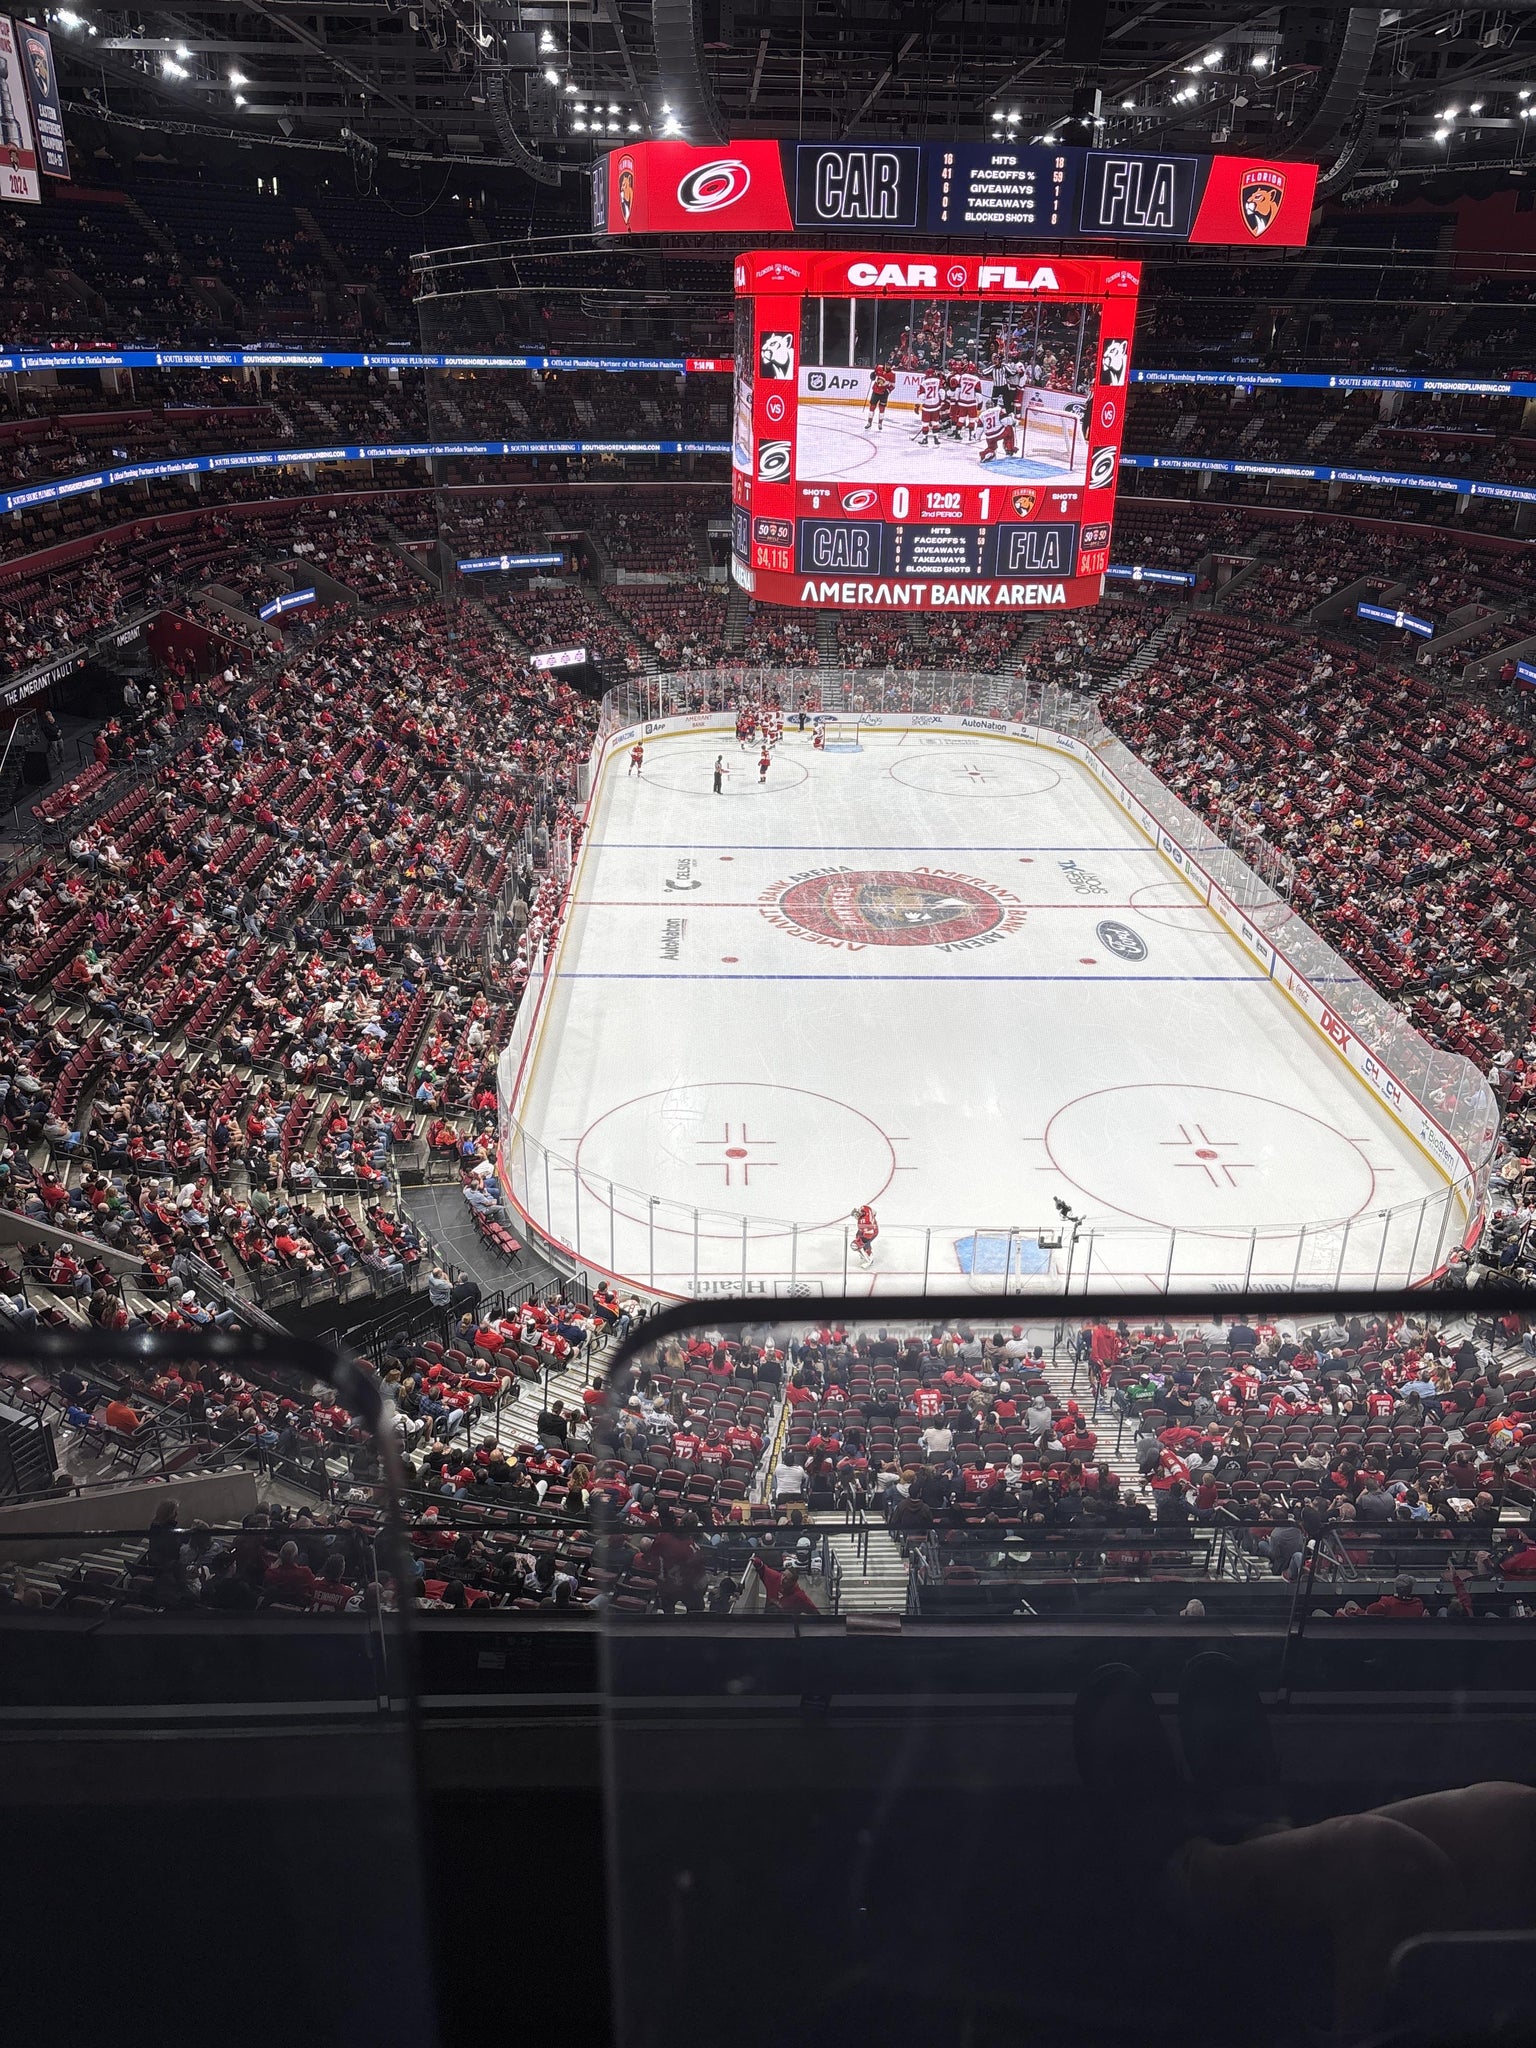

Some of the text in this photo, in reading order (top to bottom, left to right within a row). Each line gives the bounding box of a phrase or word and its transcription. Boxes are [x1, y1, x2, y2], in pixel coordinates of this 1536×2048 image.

[991, 156, 1017, 166] HITS
[941, 168, 1063, 183] 41 FACEOFFS % 59
[1245, 173, 1282, 186] FLORIDA
[9, 175, 28, 195] 2024
[816, 152, 899, 218] CAR
[970, 184, 1033, 194] GIVEAWAYS
[1055, 186, 1059, 197] 1
[1100, 161, 1174, 227] FLA
[942, 196, 1058, 211] 0 TAKEAWAYS 1
[941, 211, 947, 222] 4
[965, 212, 1005, 222] BLOCKED
[1005, 213, 1035, 223] SHOTS
[847, 262, 1059, 290] CAR VS FLA
[163, 356, 182, 364] SOUTH
[184, 355, 202, 363] SHORE
[371, 356, 390, 365] SOUTH
[391, 356, 408, 364] SHORE
[551, 359, 684, 368] Official Plumbing Partner of the Florida Panthers
[1146, 373, 1167, 382] Official
[1168, 374, 1196, 382] Plumbing
[1196, 374, 1217, 382] Partner
[1236, 375, 1256, 383] Florida
[1257, 376, 1282, 384] Panthers
[1338, 378, 1360, 386] SOUTH
[1361, 378, 1382, 387] SHORE
[1382, 380, 1412, 388] PLUMBING
[926, 386, 936, 399] 21
[962, 382, 974, 395] 72
[770, 403, 782, 413] VS
[1104, 409, 1112, 420] VS
[986, 416, 996, 430] 31
[367, 449, 386, 457] Official
[386, 448, 410, 458] Plumbing
[444, 446, 463, 454] Florida
[530, 444, 548, 452] SHORE
[684, 444, 730, 452] Official Plumbing
[1161, 460, 1182, 468] SOUTH
[1201, 462, 1229, 470] PLUMBING
[1338, 472, 1356, 480] Official
[1381, 475, 1400, 484] Partner
[1408, 478, 1418, 486] the
[1418, 478, 1436, 488] Florida
[802, 489, 830, 497] SHOTS
[892, 486, 909, 519] 0
[926, 492, 961, 509] 12:02
[978, 488, 990, 520] 1
[1060, 500, 1067, 513] 8
[758, 524, 788, 538] 50 50
[931, 527, 951, 535] HITS
[813, 528, 869, 567] CAR
[914, 546, 965, 554] GIVEAWAYS
[1009, 532, 1060, 569] FLA
[757, 547, 789, 569] $4,115
[1081, 552, 1105, 572] $4,115
[801, 581, 1066, 605] AMERANT BANK ARENA
[116, 625, 140, 648] AMERANT
[4, 661, 73, 706] THE AMERANT VAULT
[961, 718, 1007, 732] AutoNation
[676, 858, 691, 880] CELSIUS
[758, 865, 867, 951] AMERANT BANK ARENA
[912, 866, 1027, 952] AMERANT BANK ARENA
[660, 918, 681, 961] AutoNation
[1320, 1009, 1352, 1054] DEX
[1428, 1130, 1454, 1163] BioStem
[688, 1280, 767, 1294] Health
[922, 1400, 938, 1416] 63
[975, 1480, 988, 1489] 16
